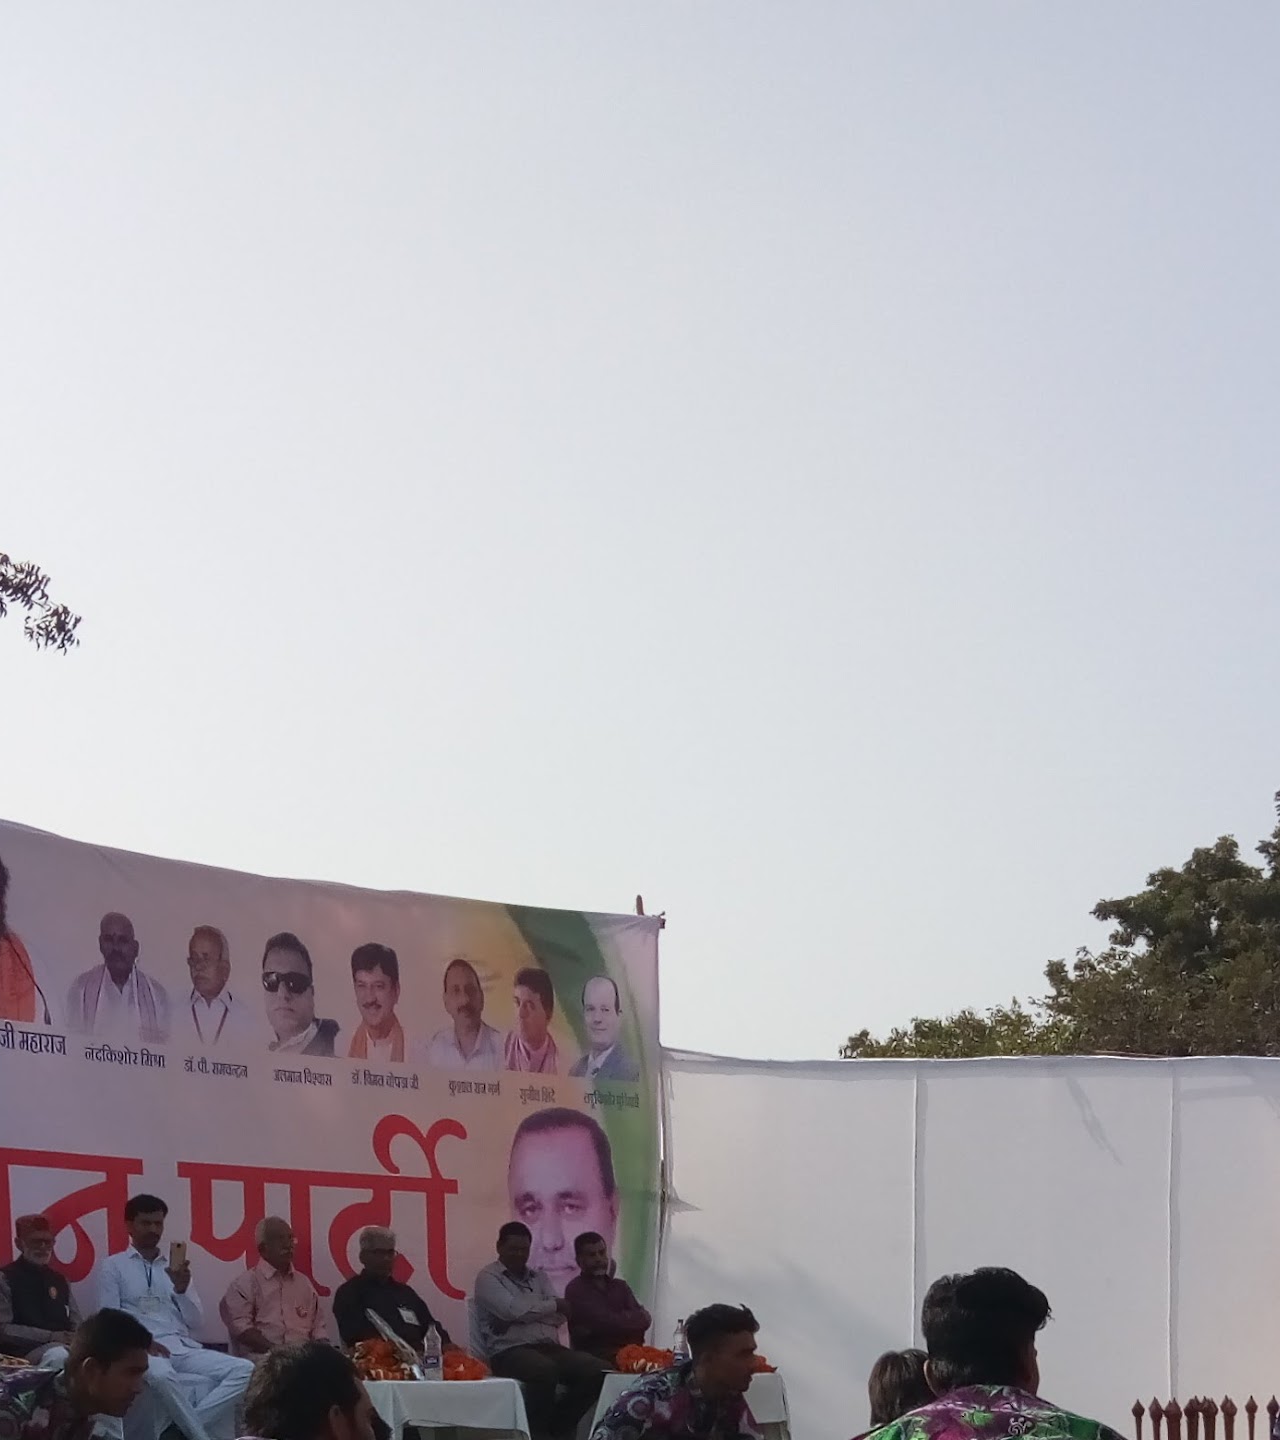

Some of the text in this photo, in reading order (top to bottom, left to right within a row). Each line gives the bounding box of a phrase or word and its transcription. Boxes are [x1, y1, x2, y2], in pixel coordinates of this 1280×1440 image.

[19, 1030, 67, 1056] महाराज
[84, 1043, 139, 1065] नंदकिशोर
[177, 1114, 467, 1300] पार्टी
